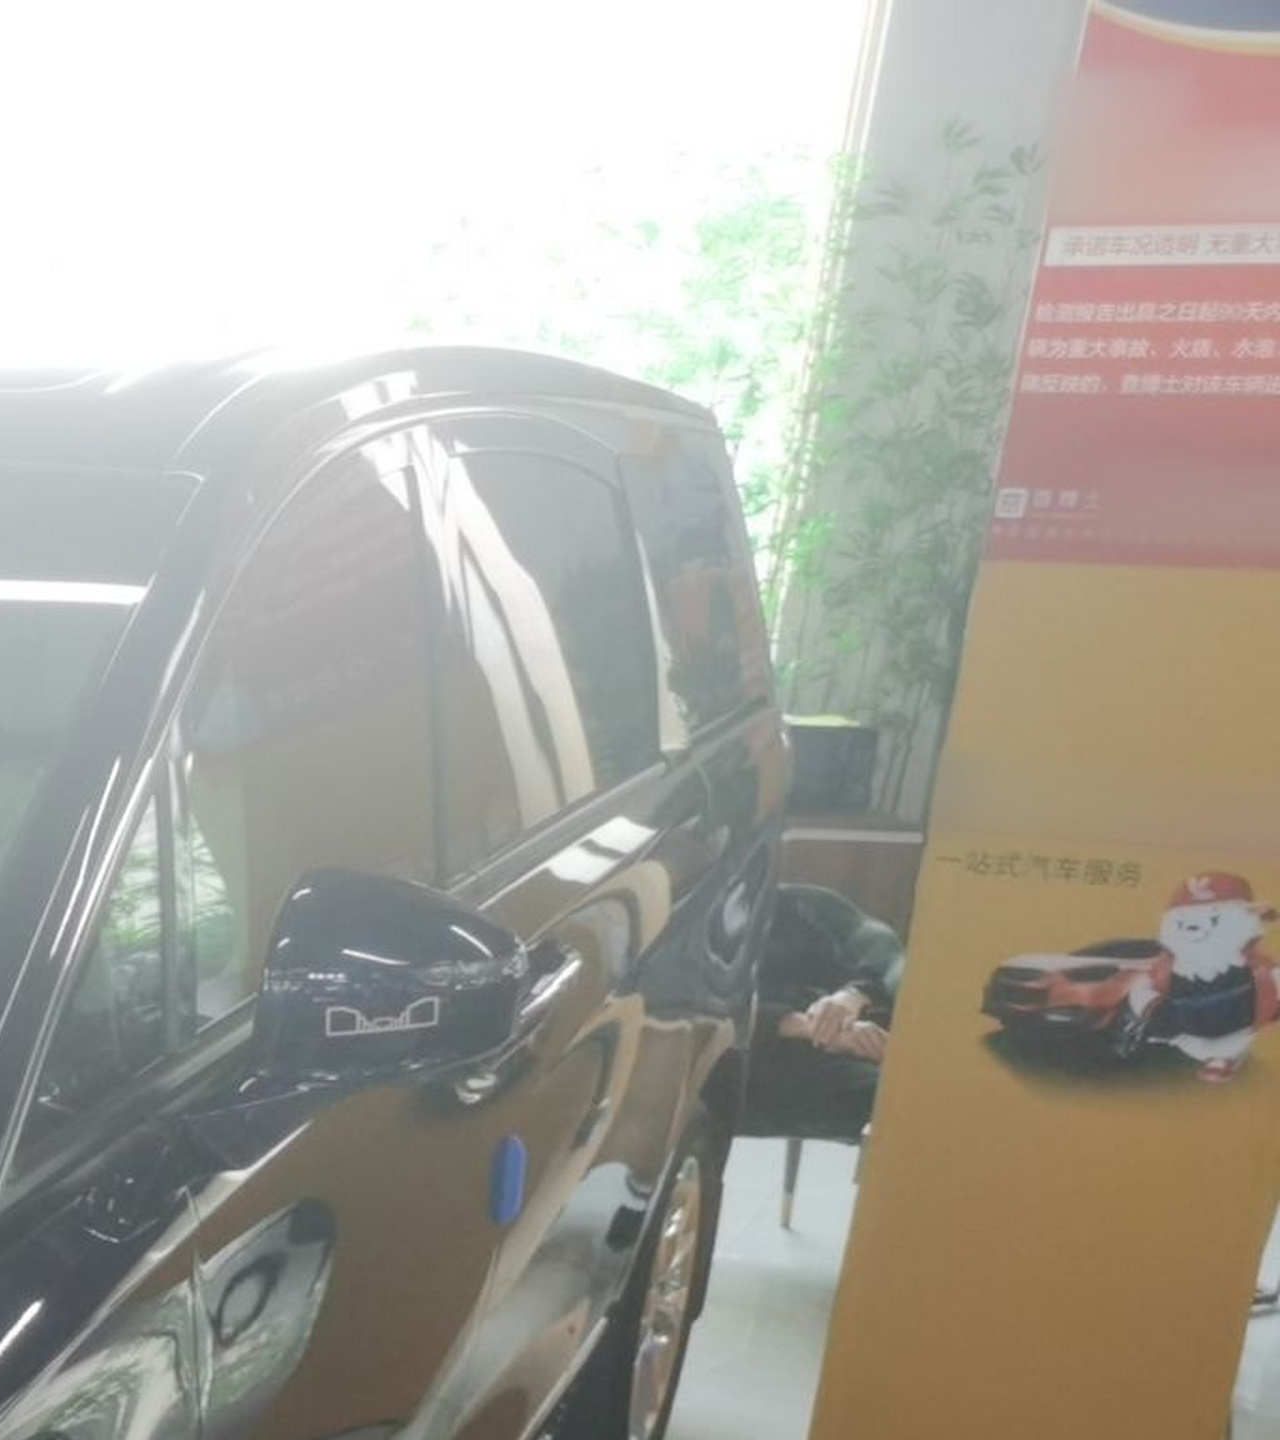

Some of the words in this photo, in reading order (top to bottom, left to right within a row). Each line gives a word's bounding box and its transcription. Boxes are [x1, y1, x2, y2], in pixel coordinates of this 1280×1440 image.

[936, 850, 1145, 889] 一站式汽车服务
